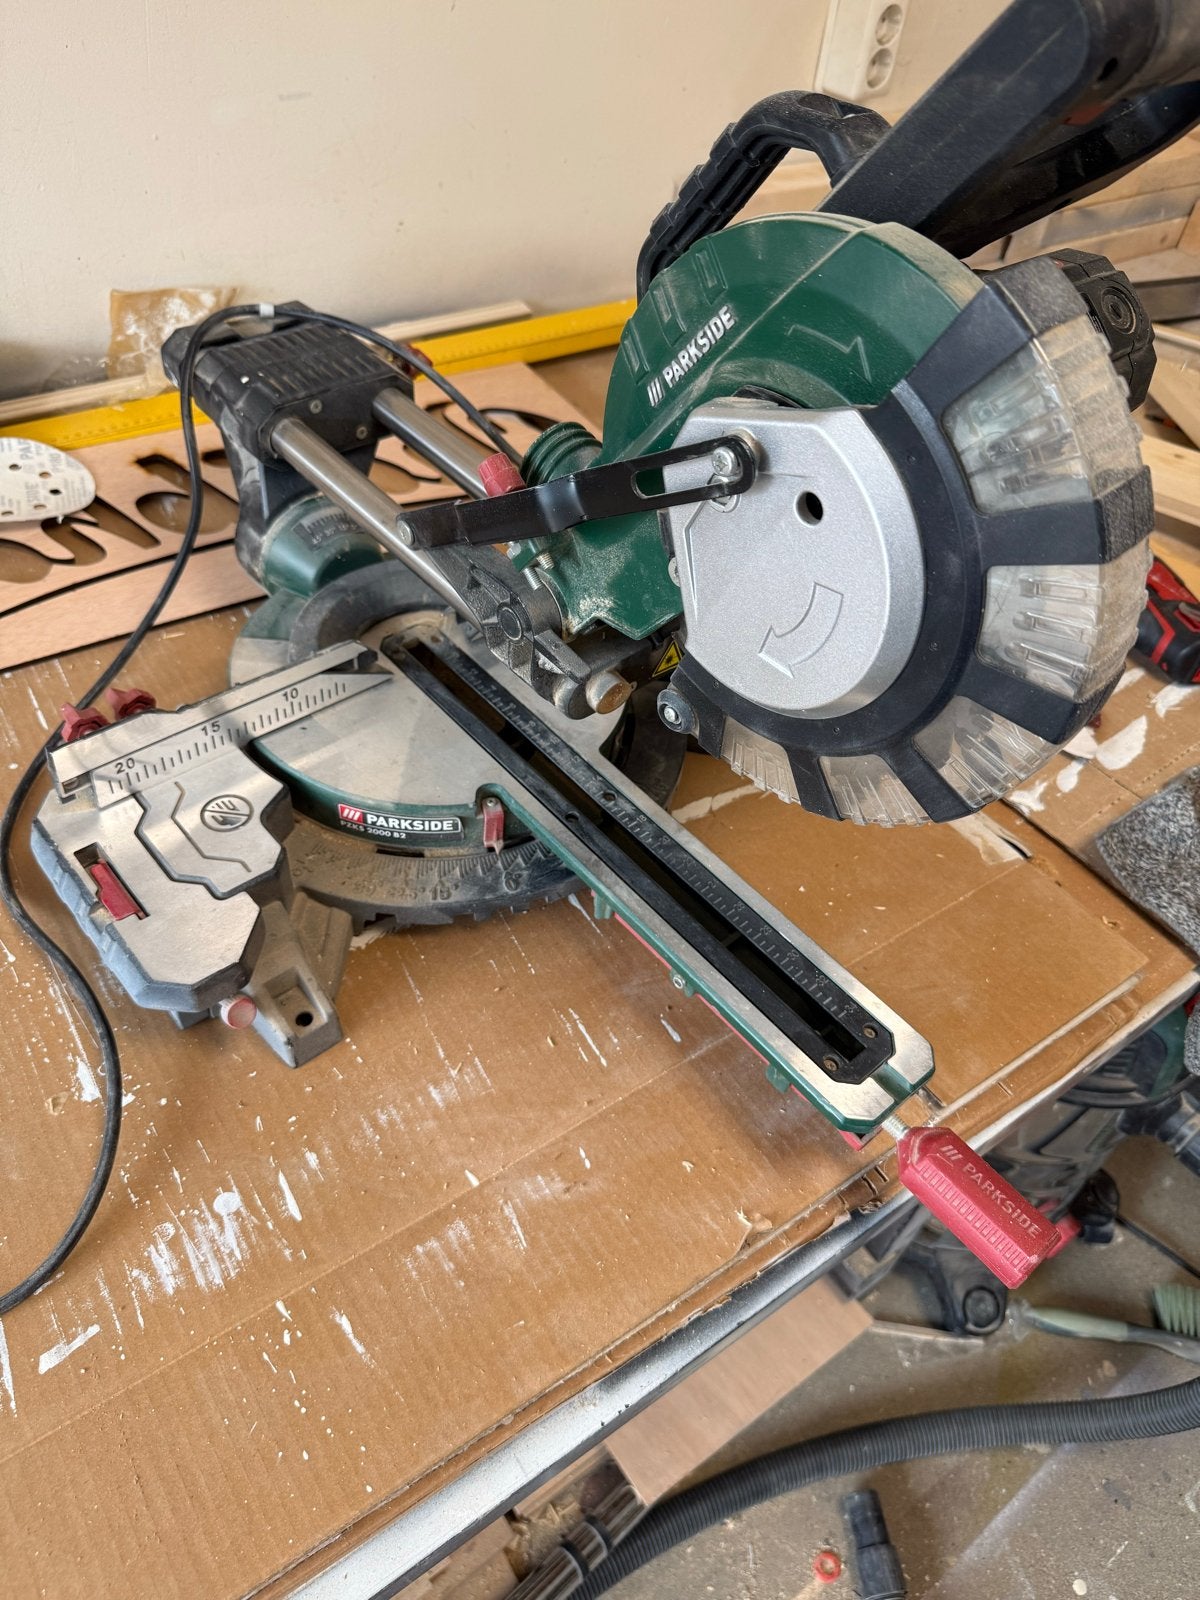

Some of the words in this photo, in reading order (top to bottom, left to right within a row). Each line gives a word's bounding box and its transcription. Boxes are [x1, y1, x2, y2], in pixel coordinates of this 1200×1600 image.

[662, 305, 736, 388] PARKSIDE
[114, 757, 136, 775] 20
[201, 721, 221, 737] 15
[282, 687, 299, 703] 10
[340, 820, 365, 832] PZKS
[367, 827, 391, 837] 2000
[393, 831, 406, 839] B2
[366, 813, 453, 831] PARKSIDE
[962, 1162, 1041, 1239] PARKSIDE
